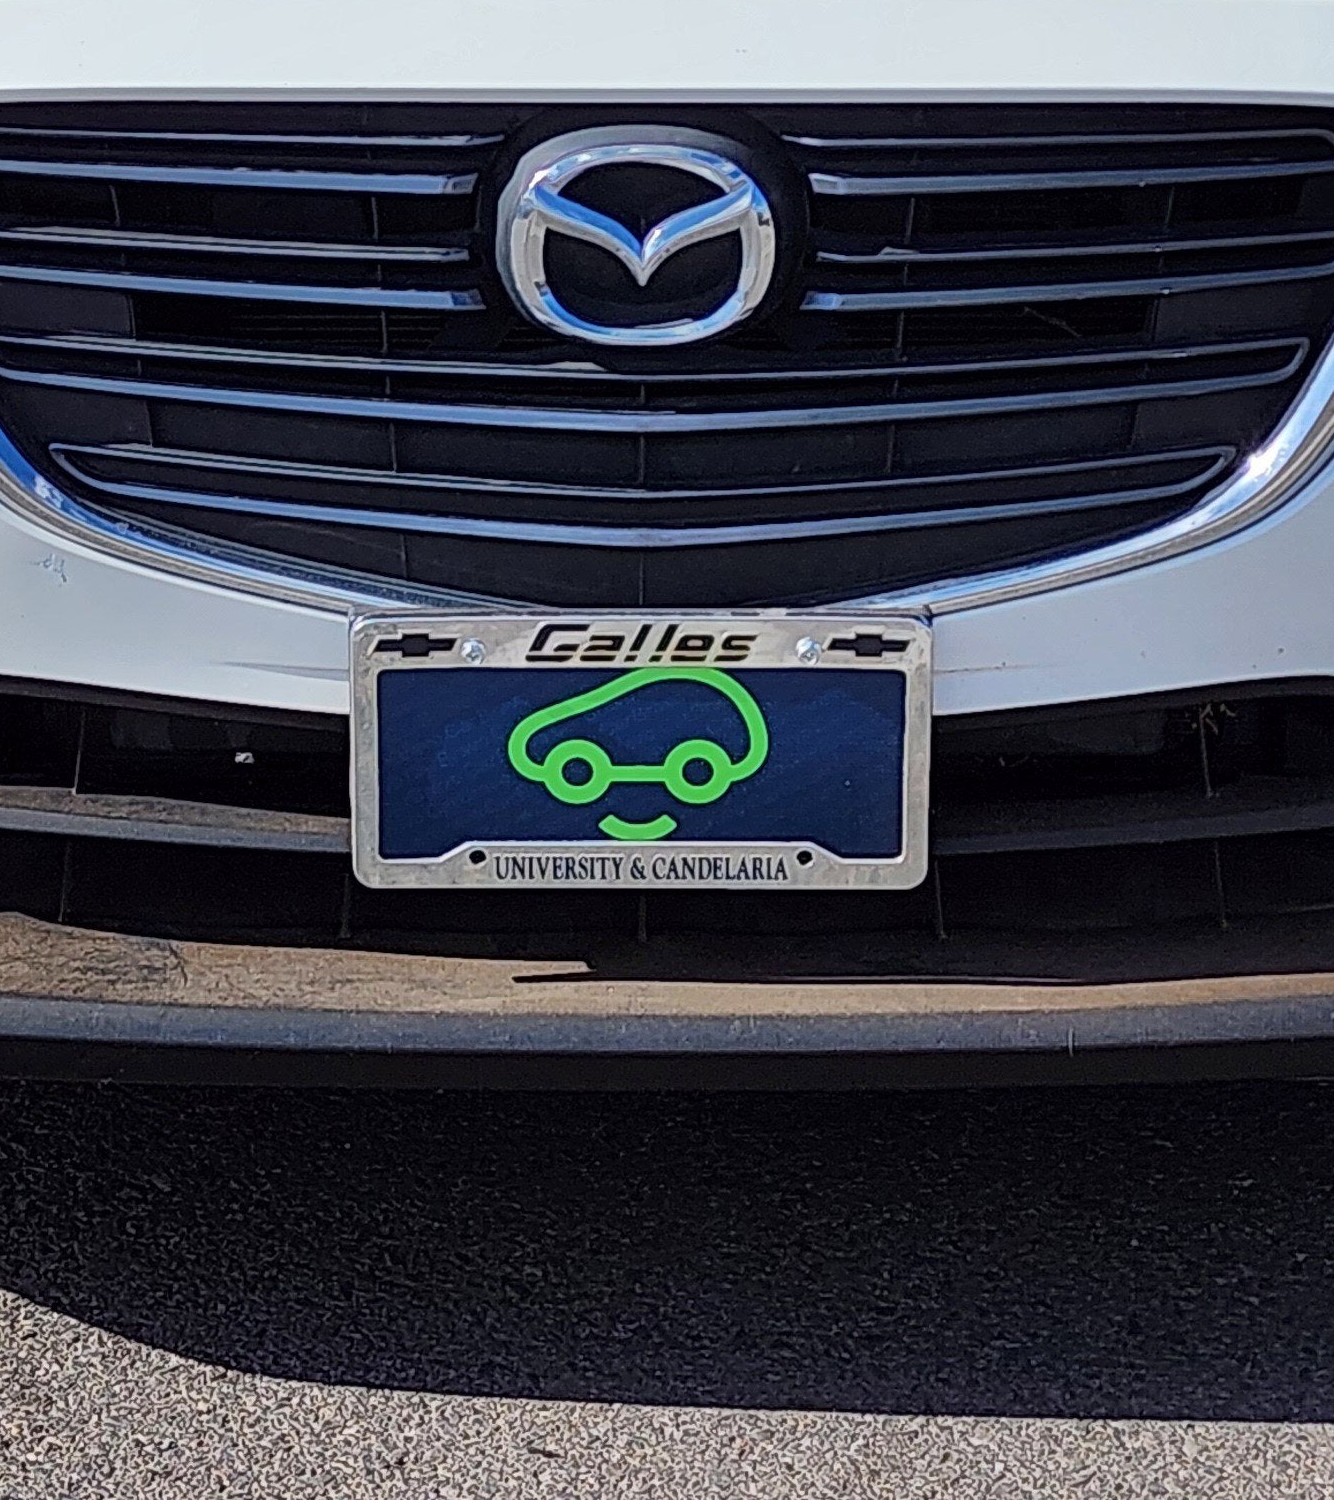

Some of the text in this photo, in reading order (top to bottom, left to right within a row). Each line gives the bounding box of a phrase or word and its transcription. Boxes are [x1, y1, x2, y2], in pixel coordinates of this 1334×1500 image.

[525, 622, 762, 664] Galles
[494, 855, 789, 882] UNIVERSITY & CANDELARIA
